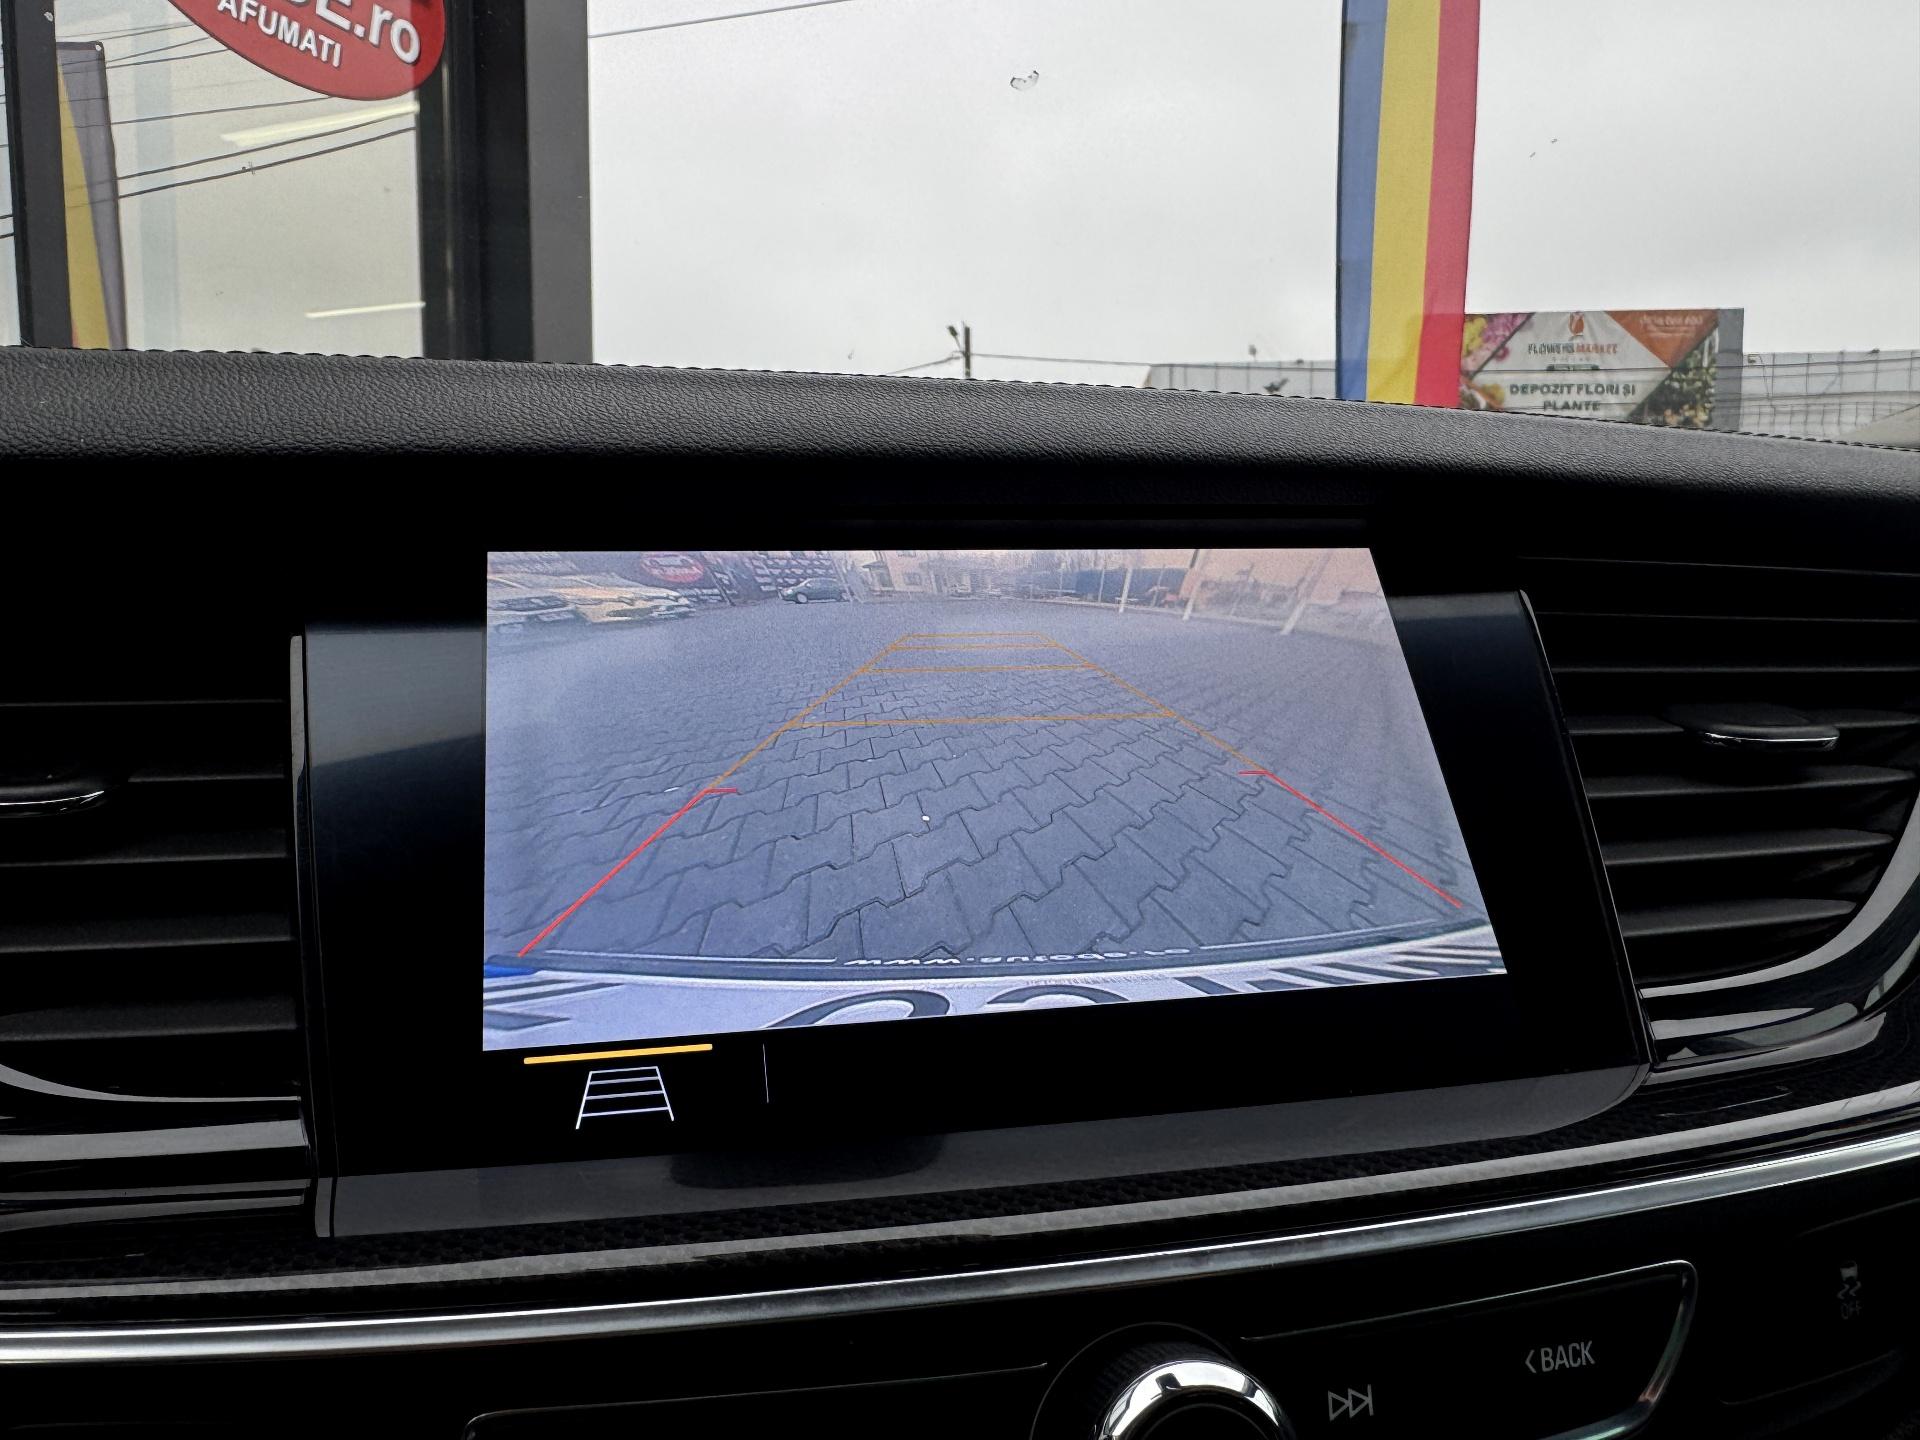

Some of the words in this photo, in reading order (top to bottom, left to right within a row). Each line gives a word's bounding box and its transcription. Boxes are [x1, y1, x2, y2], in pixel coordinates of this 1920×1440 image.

[216, 0, 342, 68] AFUMATI
[296, 0, 421, 64] E.ro
[1509, 383, 1575, 395] DEPOZIT
[1576, 383, 1619, 395] FLORI
[1543, 400, 1600, 411] PLANTE
[1540, 1340, 1595, 1372] BACK
